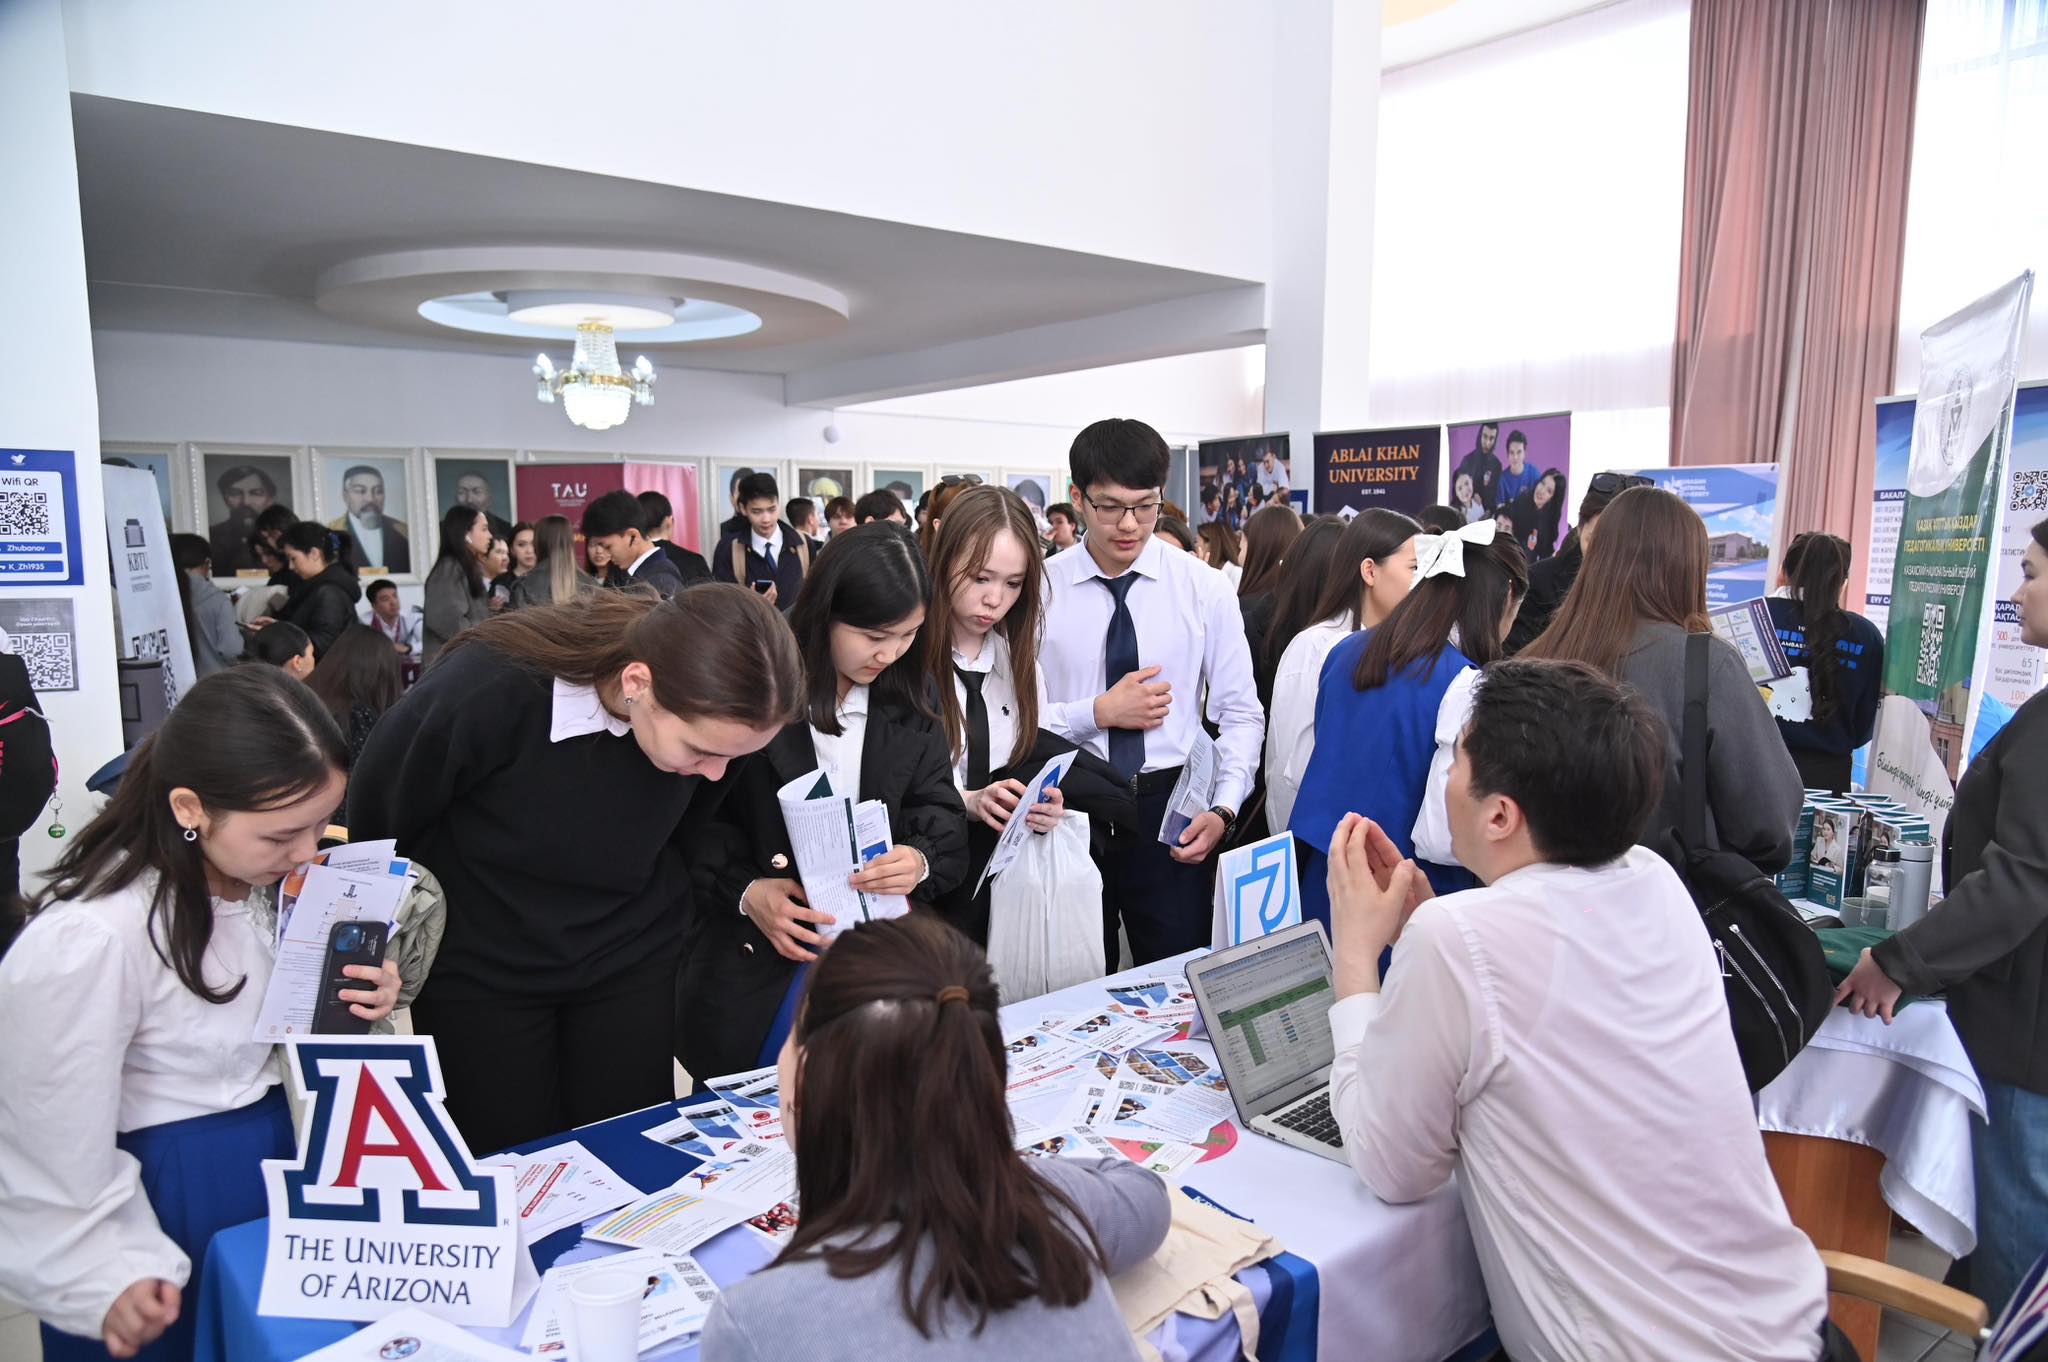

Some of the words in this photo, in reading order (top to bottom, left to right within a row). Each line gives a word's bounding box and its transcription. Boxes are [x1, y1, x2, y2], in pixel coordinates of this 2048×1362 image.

[1329, 448, 1373, 463] ABLAI
[1376, 444, 1420, 460] KHAN
[2, 477, 21, 486] Wifi
[24, 478, 39, 486] QR
[1329, 466, 1420, 484] UNIVERSITY
[552, 483, 588, 498] TAU
[7, 545, 45, 553] Zhubanov
[127, 552, 150, 571] KBTU
[2021, 658, 2033, 668] 65
[285, 1234, 335, 1262] THE
[345, 1237, 501, 1270] UNIVERSITY
[300, 1273, 338, 1299] OF
[341, 1270, 472, 1305] ARIZONA
